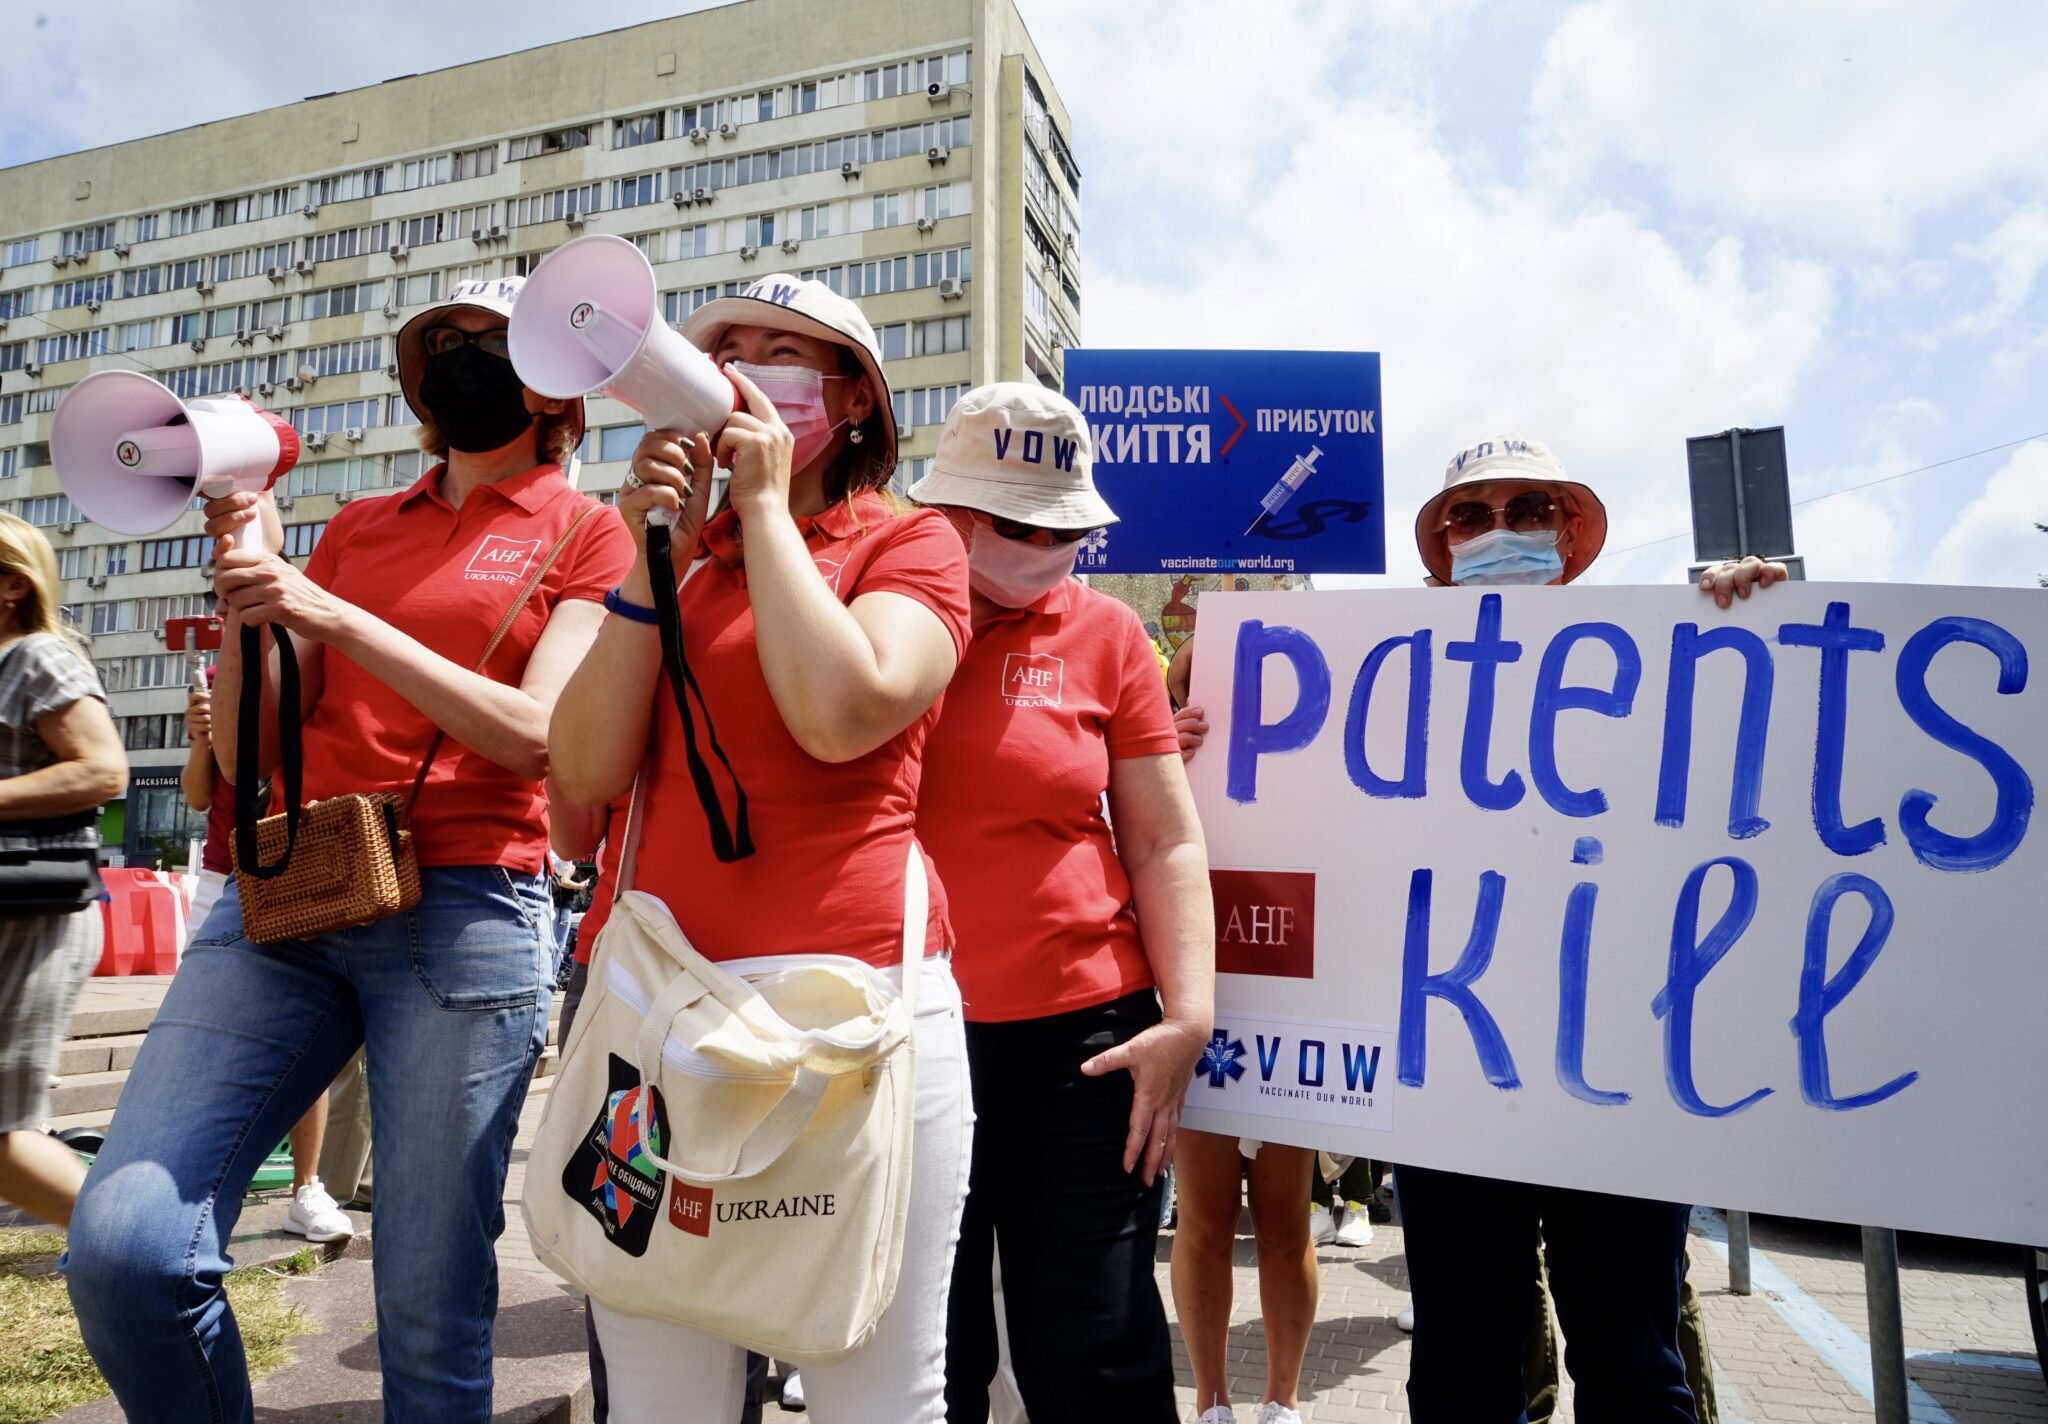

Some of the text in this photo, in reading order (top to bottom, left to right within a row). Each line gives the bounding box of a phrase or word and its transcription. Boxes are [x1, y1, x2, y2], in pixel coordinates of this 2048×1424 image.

[1078, 385, 1210, 419] ЛЮДСЬКІ
[1256, 408, 1376, 437] ПРИБУТОК
[994, 428, 1077, 472] VOW
[1456, 440, 1527, 471] VOW
[481, 548, 526, 563] AHF
[1078, 553, 1107, 565] VOW
[1160, 554, 1295, 571] vaccinateourworld.org
[464, 572, 517, 586] UKRAINE
[1011, 665, 1053, 687] AHF
[135, 777, 179, 786] BACKSTAGE
[1221, 903, 1295, 946] AHF
[1255, 1034, 1382, 1094] VOW
[1259, 1085, 1373, 1108] VACCINATE OUR WORLD
[618, 1169, 657, 1200] ОБІЦЯНКУ
[673, 1194, 835, 1223] AHF UKRAINE
